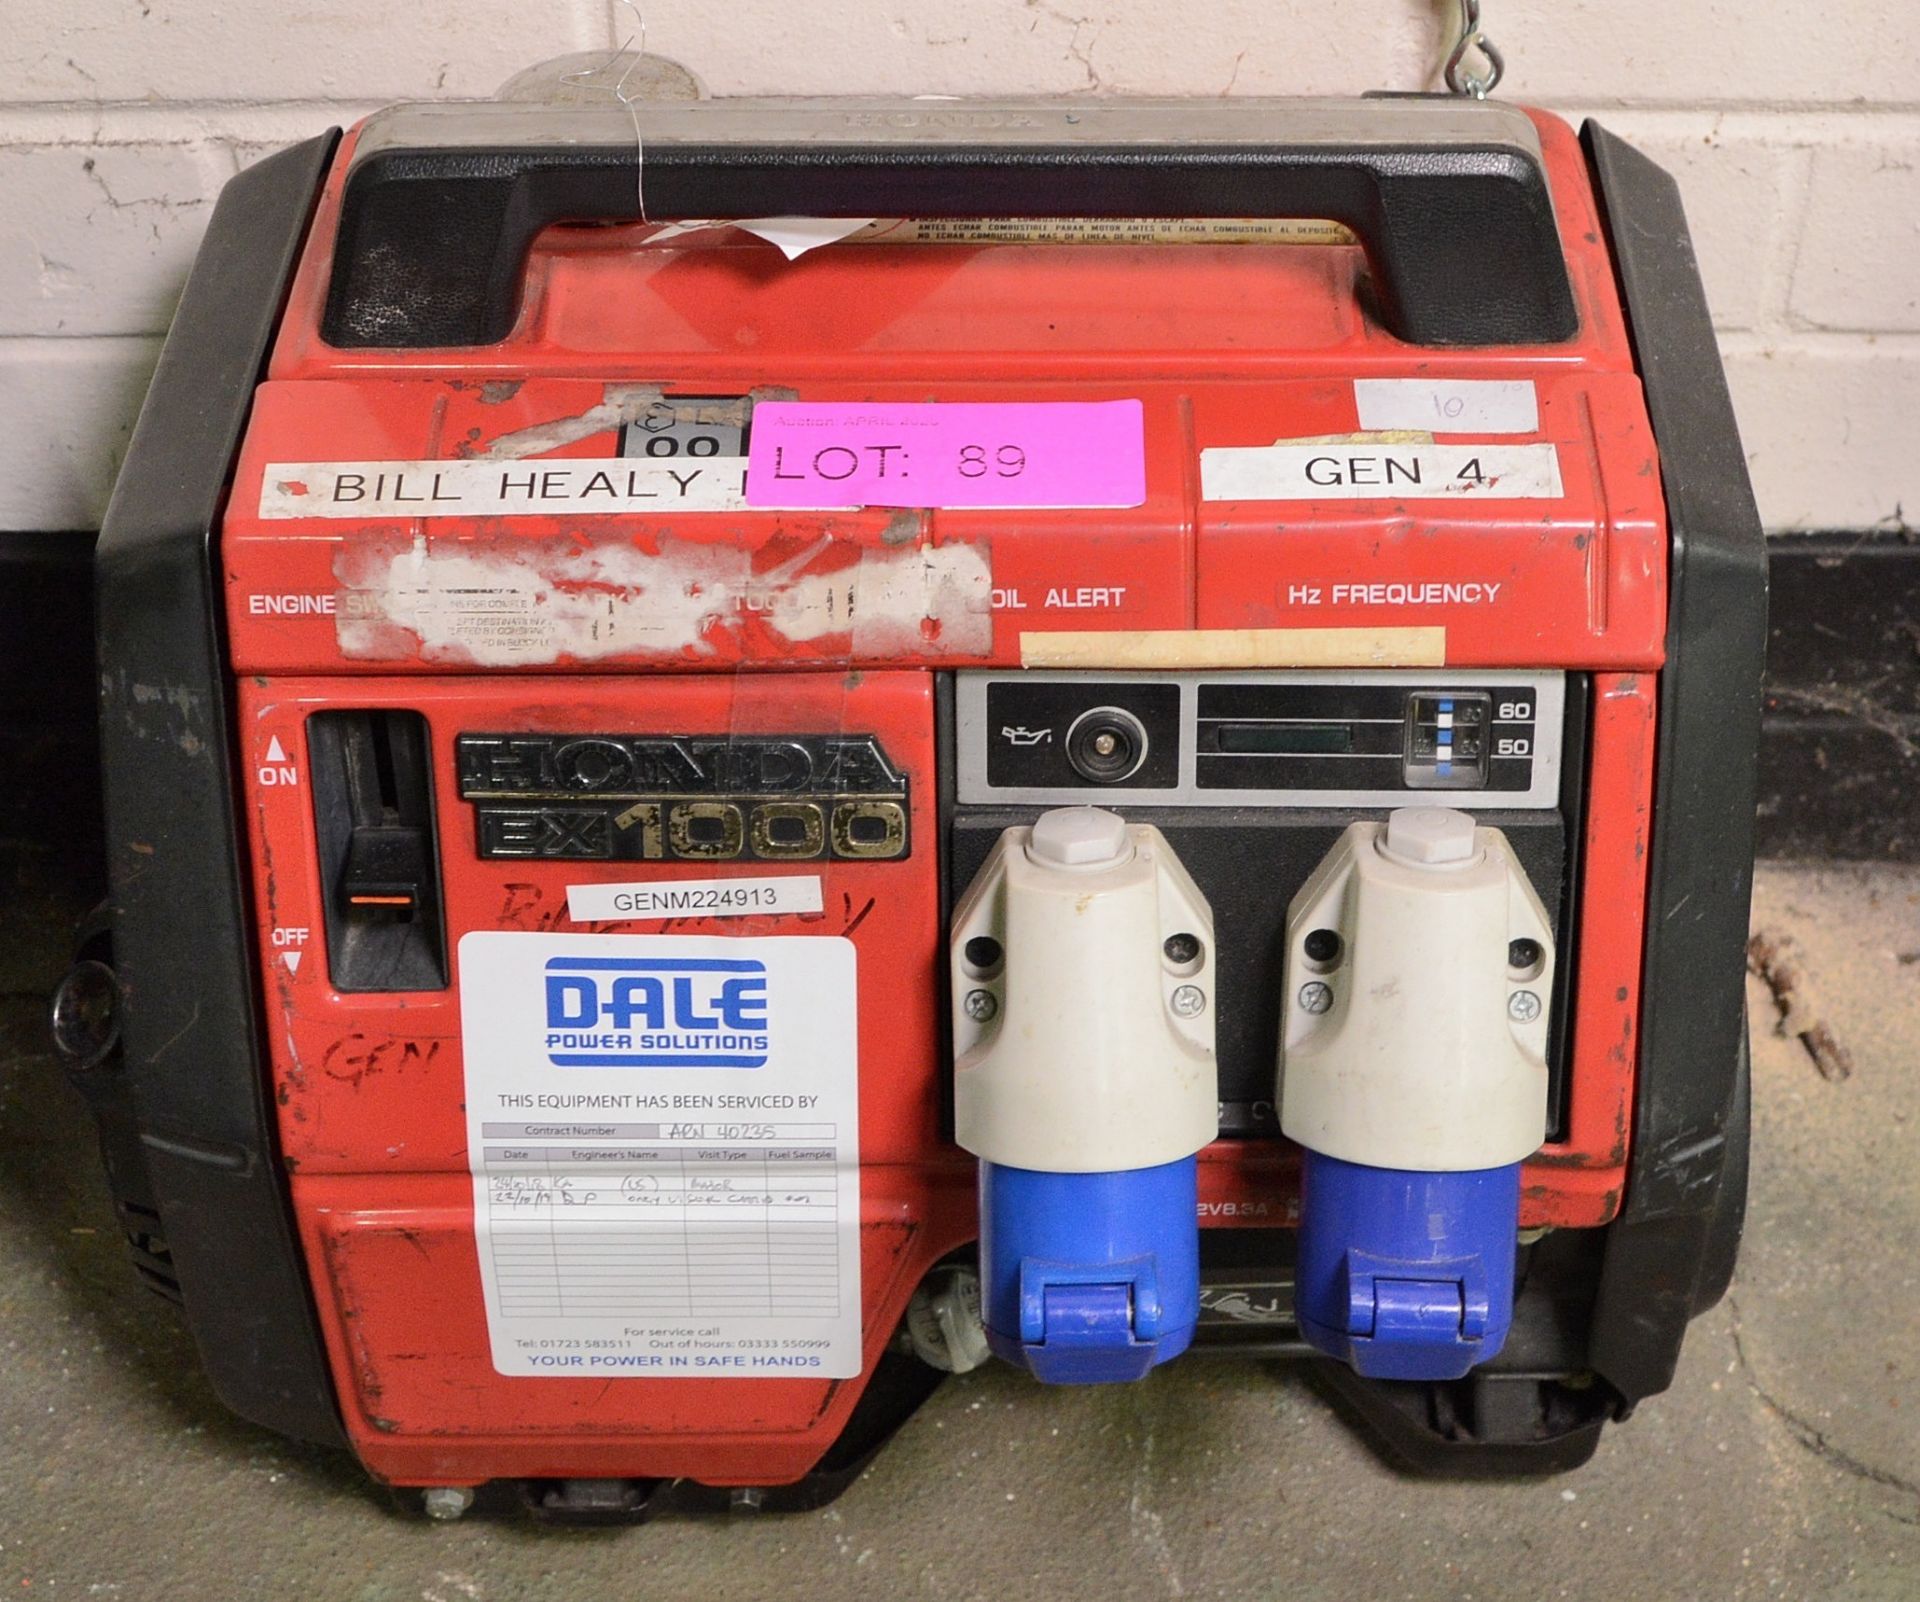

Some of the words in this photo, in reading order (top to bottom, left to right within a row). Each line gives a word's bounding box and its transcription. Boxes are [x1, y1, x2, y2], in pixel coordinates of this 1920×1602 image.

[774, 445, 909, 480] LOT:
[957, 444, 1026, 479] 89
[1305, 457, 1422, 486] GEN
[1456, 457, 1489, 485] 4
[332, 472, 463, 502] BILL
[498, 469, 704, 500] HEALY
[990, 587, 1027, 608] OIL
[1045, 587, 1127, 608] ALERT
[1287, 584, 1322, 606] Hz
[1331, 582, 1502, 606] FREQUENCY
[250, 594, 337, 615] ENGINE
[1498, 702, 1531, 719] 60
[1497, 738, 1530, 755] 50
[459, 737, 906, 793] HONDA
[258, 766, 298, 787] ON
[613, 887, 778, 913] GENM224913
[272, 927, 310, 946] OFF
[545, 975, 768, 1031] DALE
[545, 1034, 633, 1050] POWER
[641, 1035, 768, 1051] SOLUTIONS
[497, 1094, 534, 1108] THIS
[538, 1095, 633, 1110] EQUIPMENT
[636, 1095, 669, 1109] HAS
[673, 1095, 714, 1109] BEEN
[717, 1095, 794, 1109] SERVICED
[798, 1095, 819, 1109] BY
[524, 1125, 570, 1136] Contract
[573, 1125, 617, 1136] Number
[503, 1150, 529, 1160] Date
[571, 1150, 625, 1161] Engineer's
[627, 1150, 659, 1160] Name
[698, 1151, 721, 1160] Visit
[722, 1151, 747, 1162] Type
[768, 1151, 791, 1160] Fuel
[792, 1151, 833, 1162] Sample
[623, 1327, 645, 1337] For
[649, 1328, 695, 1337] service
[698, 1327, 721, 1337] call
[515, 1339, 538, 1349] Tel:
[540, 1339, 581, 1349] 01723
[585, 1339, 632, 1349] 583511
[648, 1339, 674, 1349] Out
[677, 1339, 691, 1349] of
[694, 1339, 735, 1349] hours:
[738, 1339, 779, 1349] 03333
[782, 1339, 831, 1349] 550999
[528, 1355, 584, 1367] YOUR
[590, 1355, 663, 1367] POWER
[669, 1355, 688, 1367] IN
[694, 1355, 746, 1367] SAFE
[752, 1355, 822, 1367] HANDS
